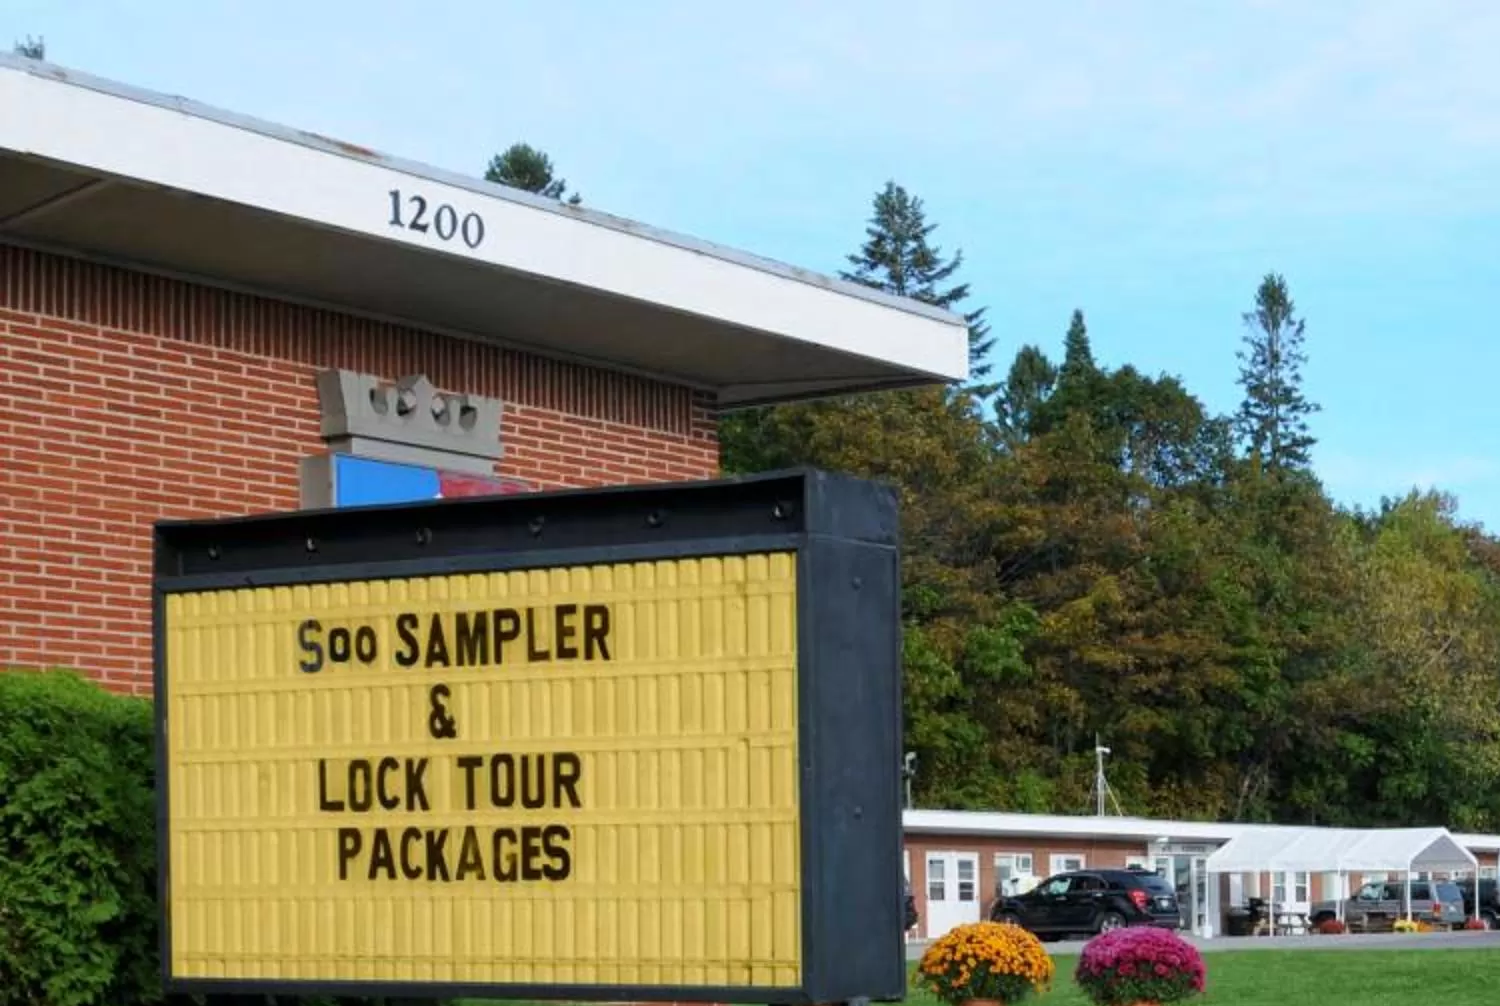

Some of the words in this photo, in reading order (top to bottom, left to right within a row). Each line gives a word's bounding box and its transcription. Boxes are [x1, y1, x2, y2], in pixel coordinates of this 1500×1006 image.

[387, 188, 486, 250] 1200
[395, 603, 612, 669] SAMPLER
[428, 683, 457, 739] &
[318, 756, 431, 812] LOCK
[456, 752, 582, 810] TOUR
[337, 824, 572, 882] PACKAGES
